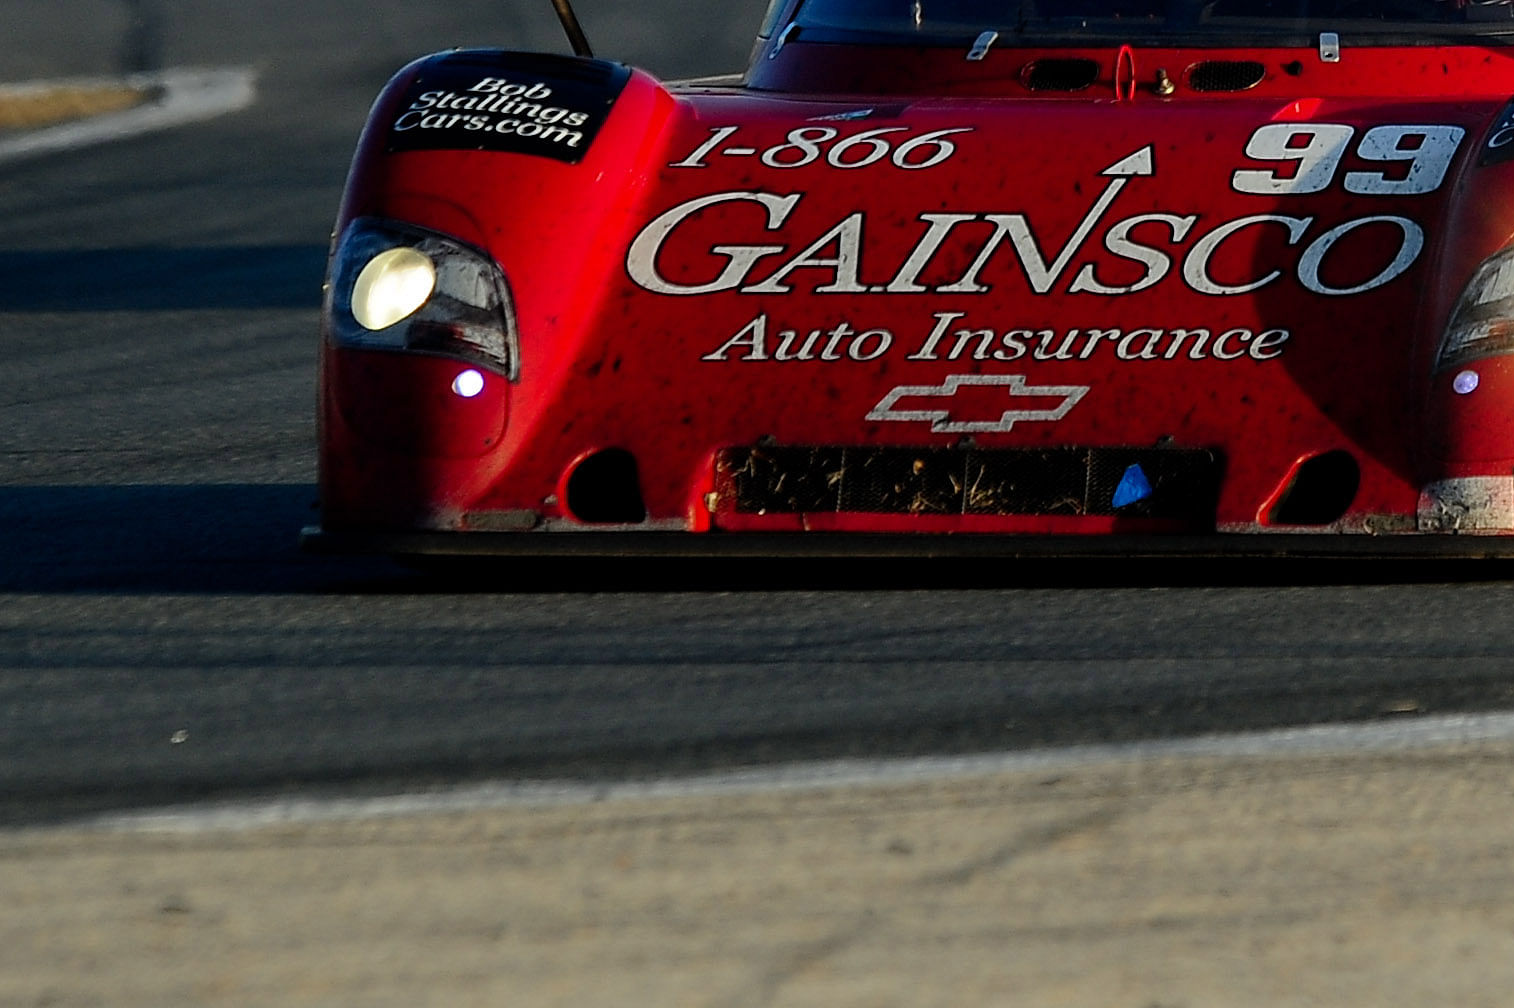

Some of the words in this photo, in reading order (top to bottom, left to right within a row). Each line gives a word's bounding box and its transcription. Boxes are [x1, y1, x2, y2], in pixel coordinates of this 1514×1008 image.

[408, 91, 589, 126] Stallings
[467, 77, 552, 99] Bob
[394, 109, 583, 148] Cars.com
[669, 125, 975, 169] 1-866
[1231, 123, 1466, 195] 99
[625, 190, 1425, 296] GAINSCO
[703, 314, 893, 363] Auto
[908, 311, 1290, 363] Insurance
